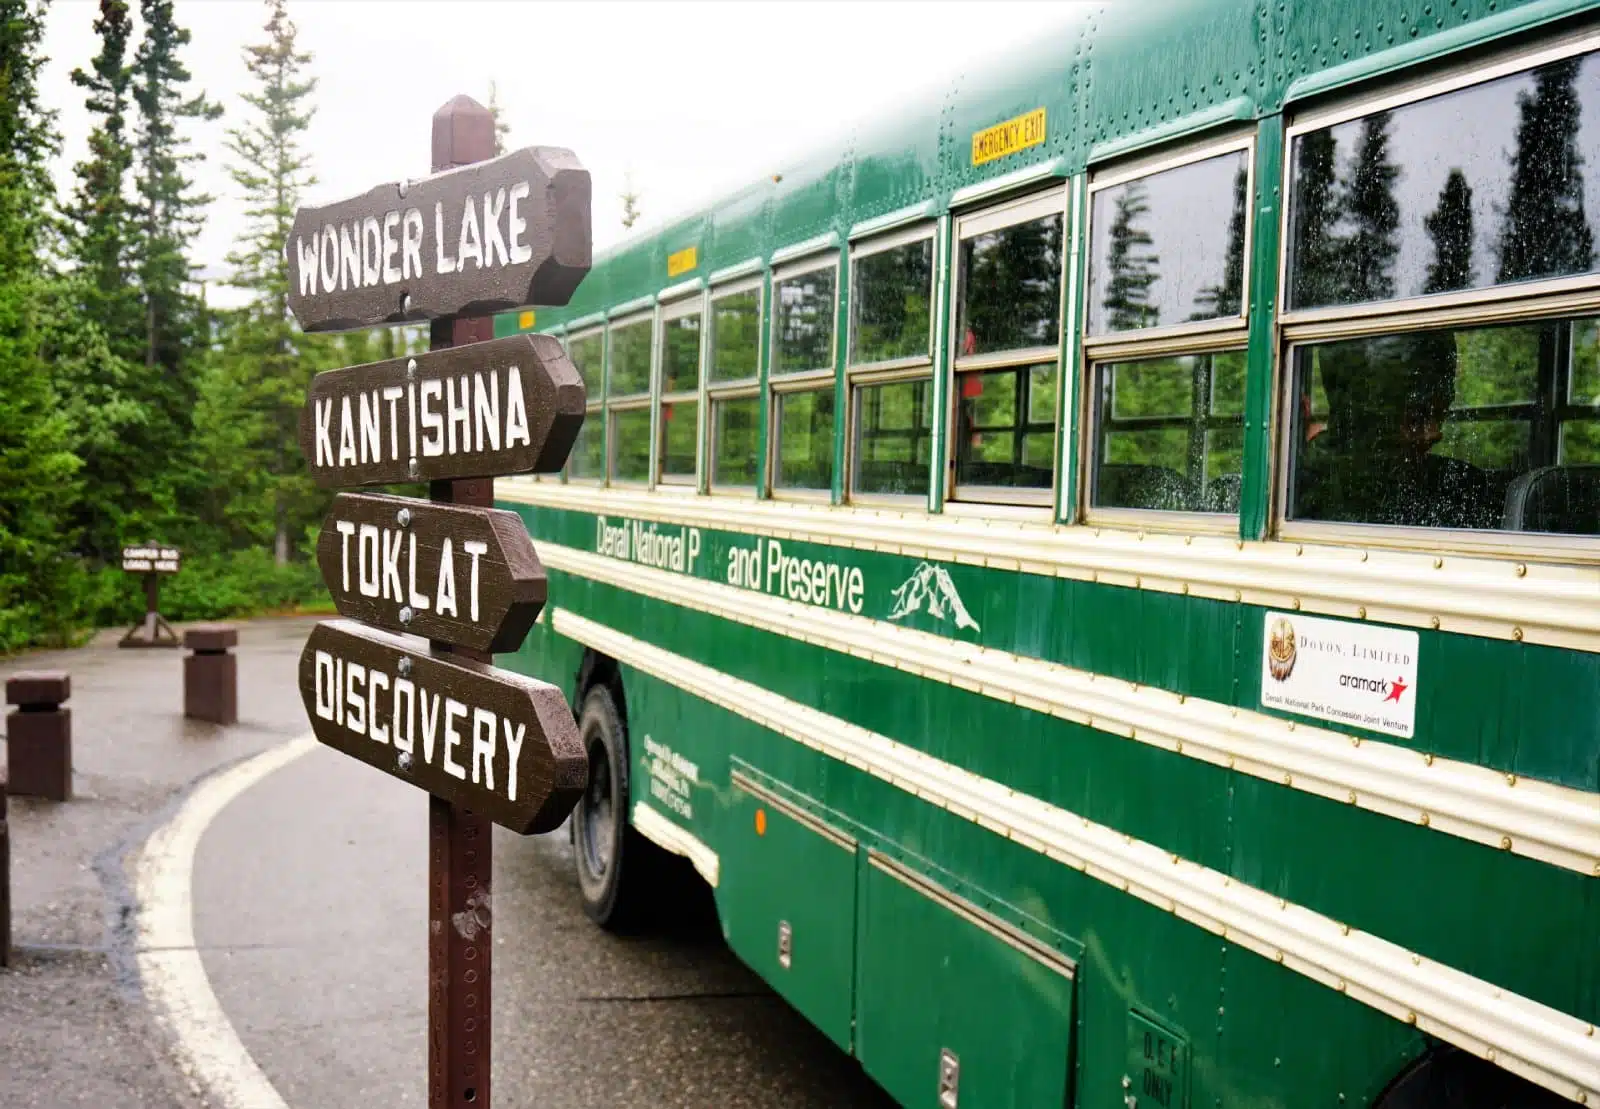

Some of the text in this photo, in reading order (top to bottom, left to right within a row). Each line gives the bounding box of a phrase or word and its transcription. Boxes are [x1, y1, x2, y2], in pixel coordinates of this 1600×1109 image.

[974, 112, 1044, 161] EMERGENCY EXIT
[297, 181, 533, 297] WONDER LAKE
[315, 365, 531, 468] KANTISHNA
[336, 519, 488, 623] TOKLAT
[597, 514, 631, 560] Denali
[632, 519, 686, 572] National
[727, 537, 762, 590] and
[766, 539, 865, 614] Preserve
[315, 650, 527, 802] DISCOVERY
[1285, 696, 1310, 709] National
[1311, 701, 1325, 712] Park
[1326, 705, 1362, 721] Concession
[1363, 713, 1380, 726] Joint
[1382, 716, 1409, 732] Venture
[1339, 674, 1388, 695] aramark
